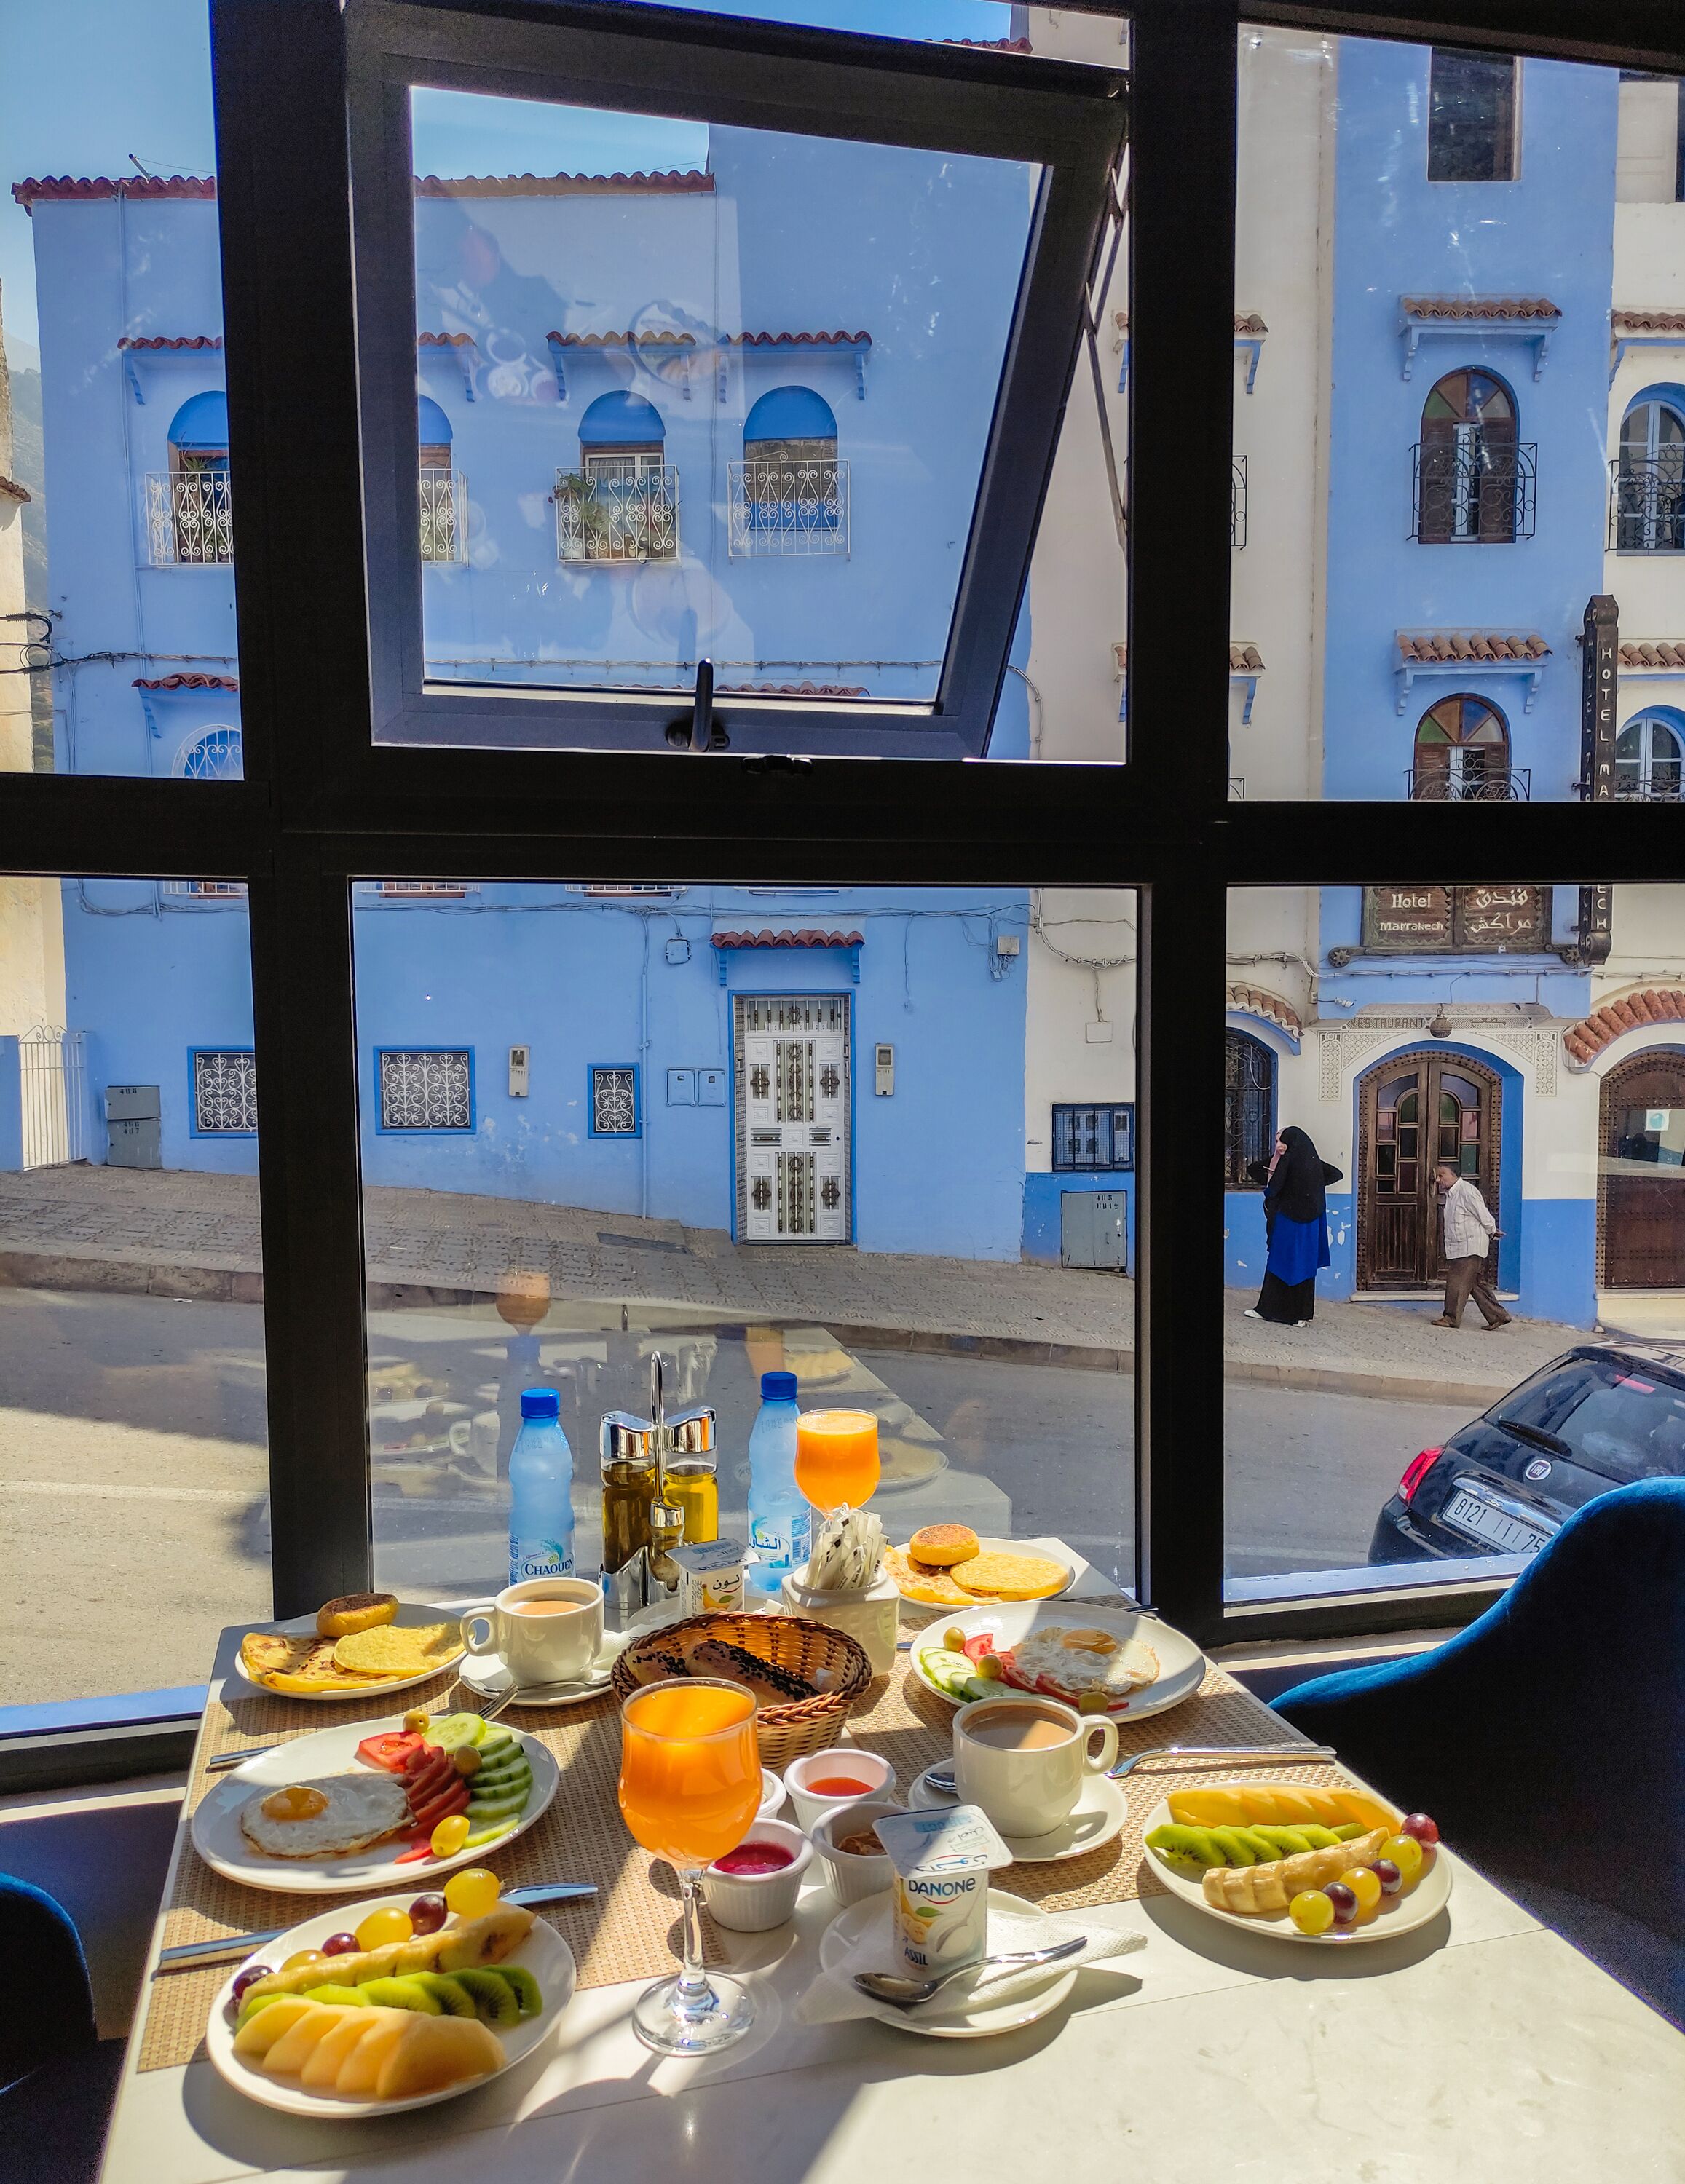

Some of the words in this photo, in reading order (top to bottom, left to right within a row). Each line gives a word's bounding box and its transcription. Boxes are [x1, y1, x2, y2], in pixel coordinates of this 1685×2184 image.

[1600, 647, 1611, 742] HOTEL
[1392, 893, 1432, 909] Hotel
[1476, 887, 1528, 909] فندق
[1380, 920, 1444, 932] Marrakech
[1470, 911, 1534, 935] مراكش
[1350, 1018, 1425, 1029] RESTAURANT
[1530, 1465, 1547, 1476] FIAT
[1454, 1498, 1487, 1526] 8121
[1521, 1533, 1546, 1553] 75
[525, 1559, 573, 1575] CHAOUEN
[904, 1947, 928, 1966] ASSIL
